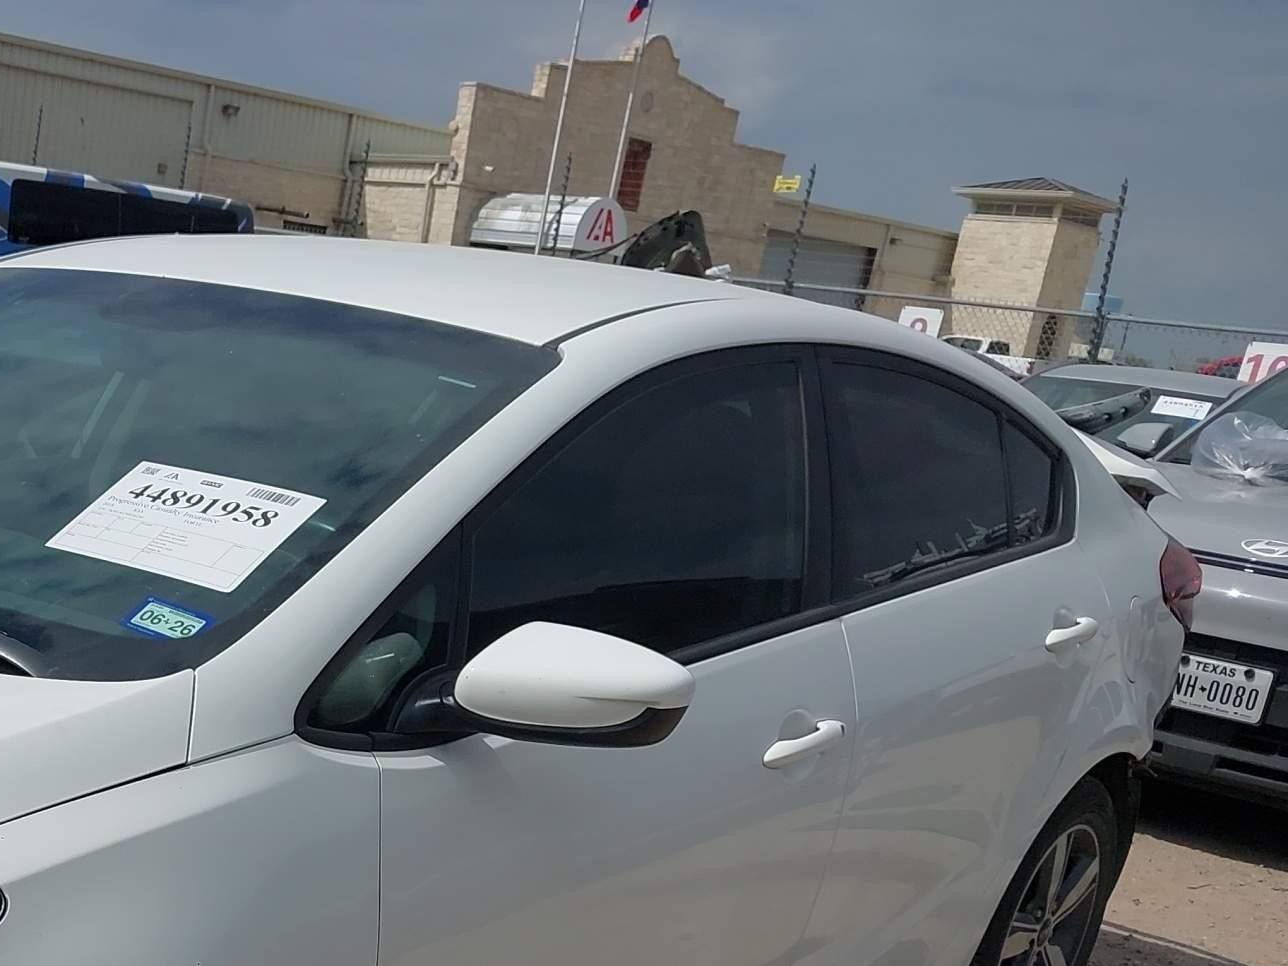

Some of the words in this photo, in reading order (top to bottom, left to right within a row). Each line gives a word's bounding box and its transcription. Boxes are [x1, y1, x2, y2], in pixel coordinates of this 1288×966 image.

[128, 483, 280, 528] 44891958
[139, 609, 166, 625] 06
[168, 620, 196, 636] 26
[1195, 661, 1237, 678] TEXAS
